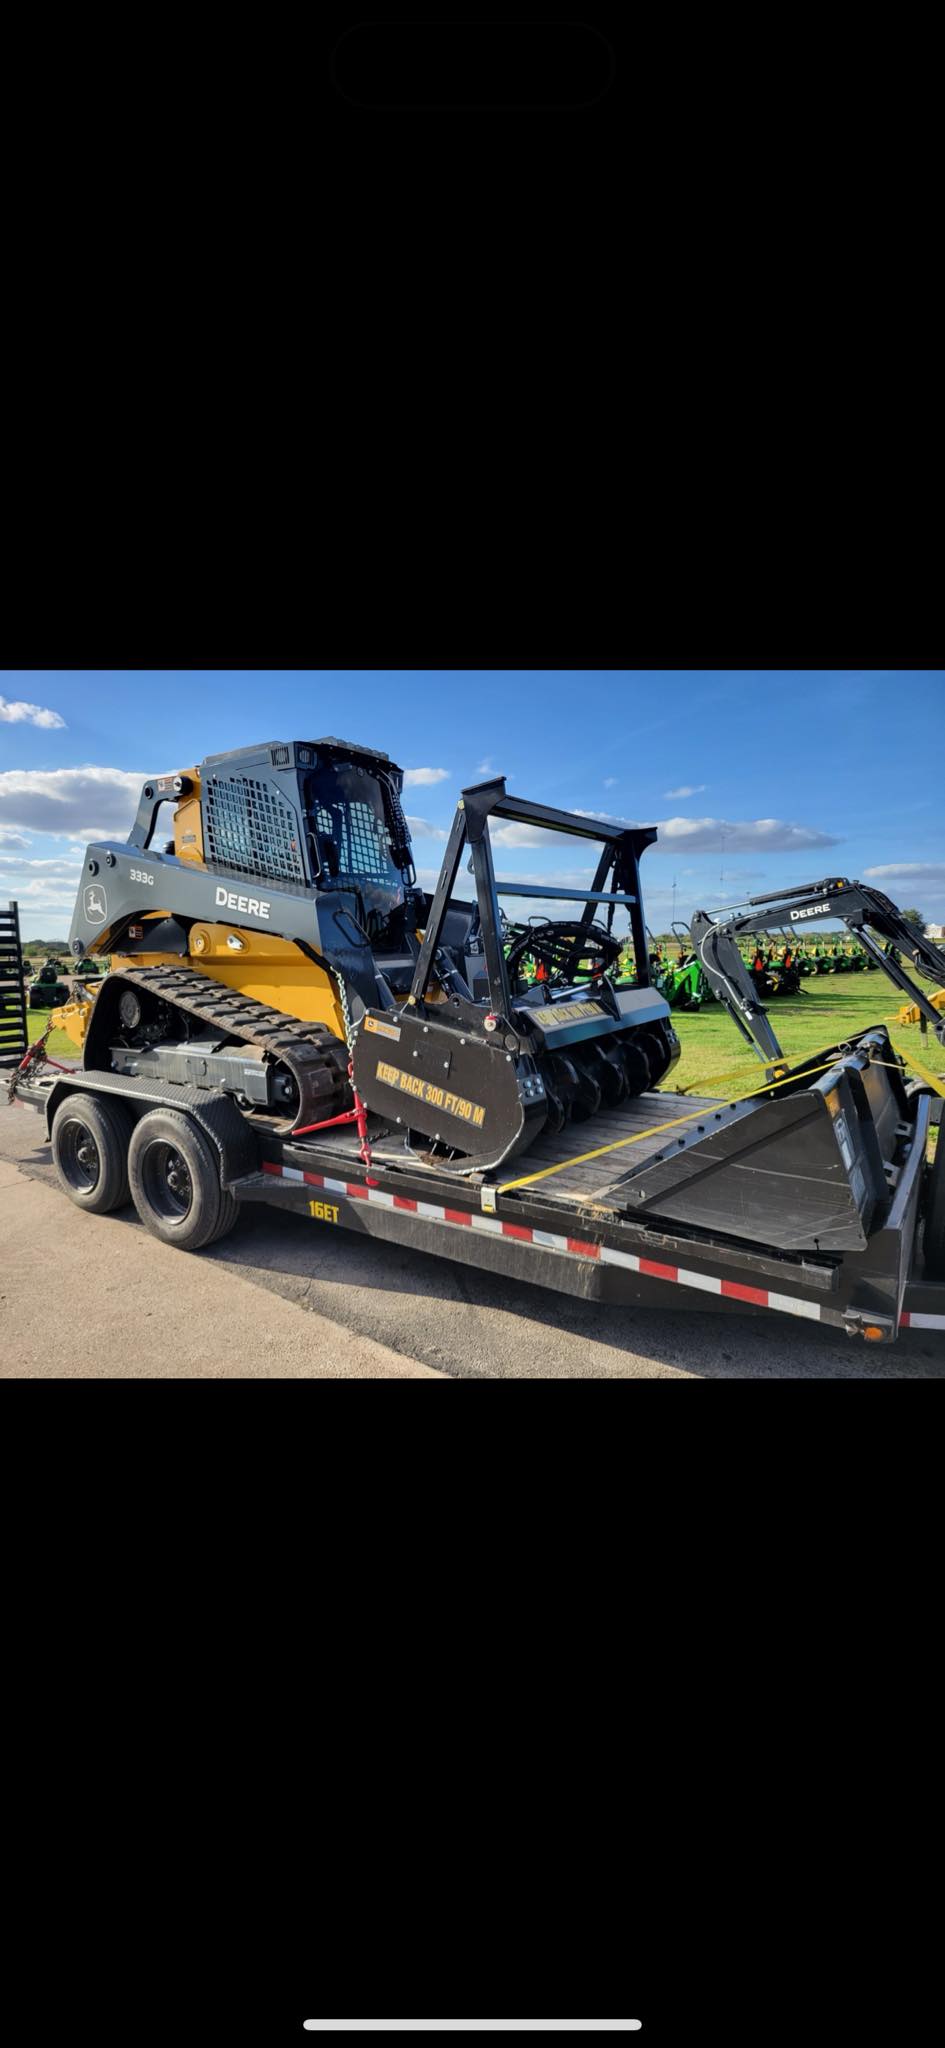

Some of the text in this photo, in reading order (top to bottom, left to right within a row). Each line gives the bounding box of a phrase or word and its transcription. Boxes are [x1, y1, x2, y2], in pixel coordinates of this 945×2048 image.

[129, 869, 154, 886] 333G
[215, 887, 271, 919] DEERE
[790, 903, 831, 920] DEERE
[376, 1061, 486, 1125] KEEP BACK 300 FT/90 M
[309, 1200, 339, 1223] 16ET
